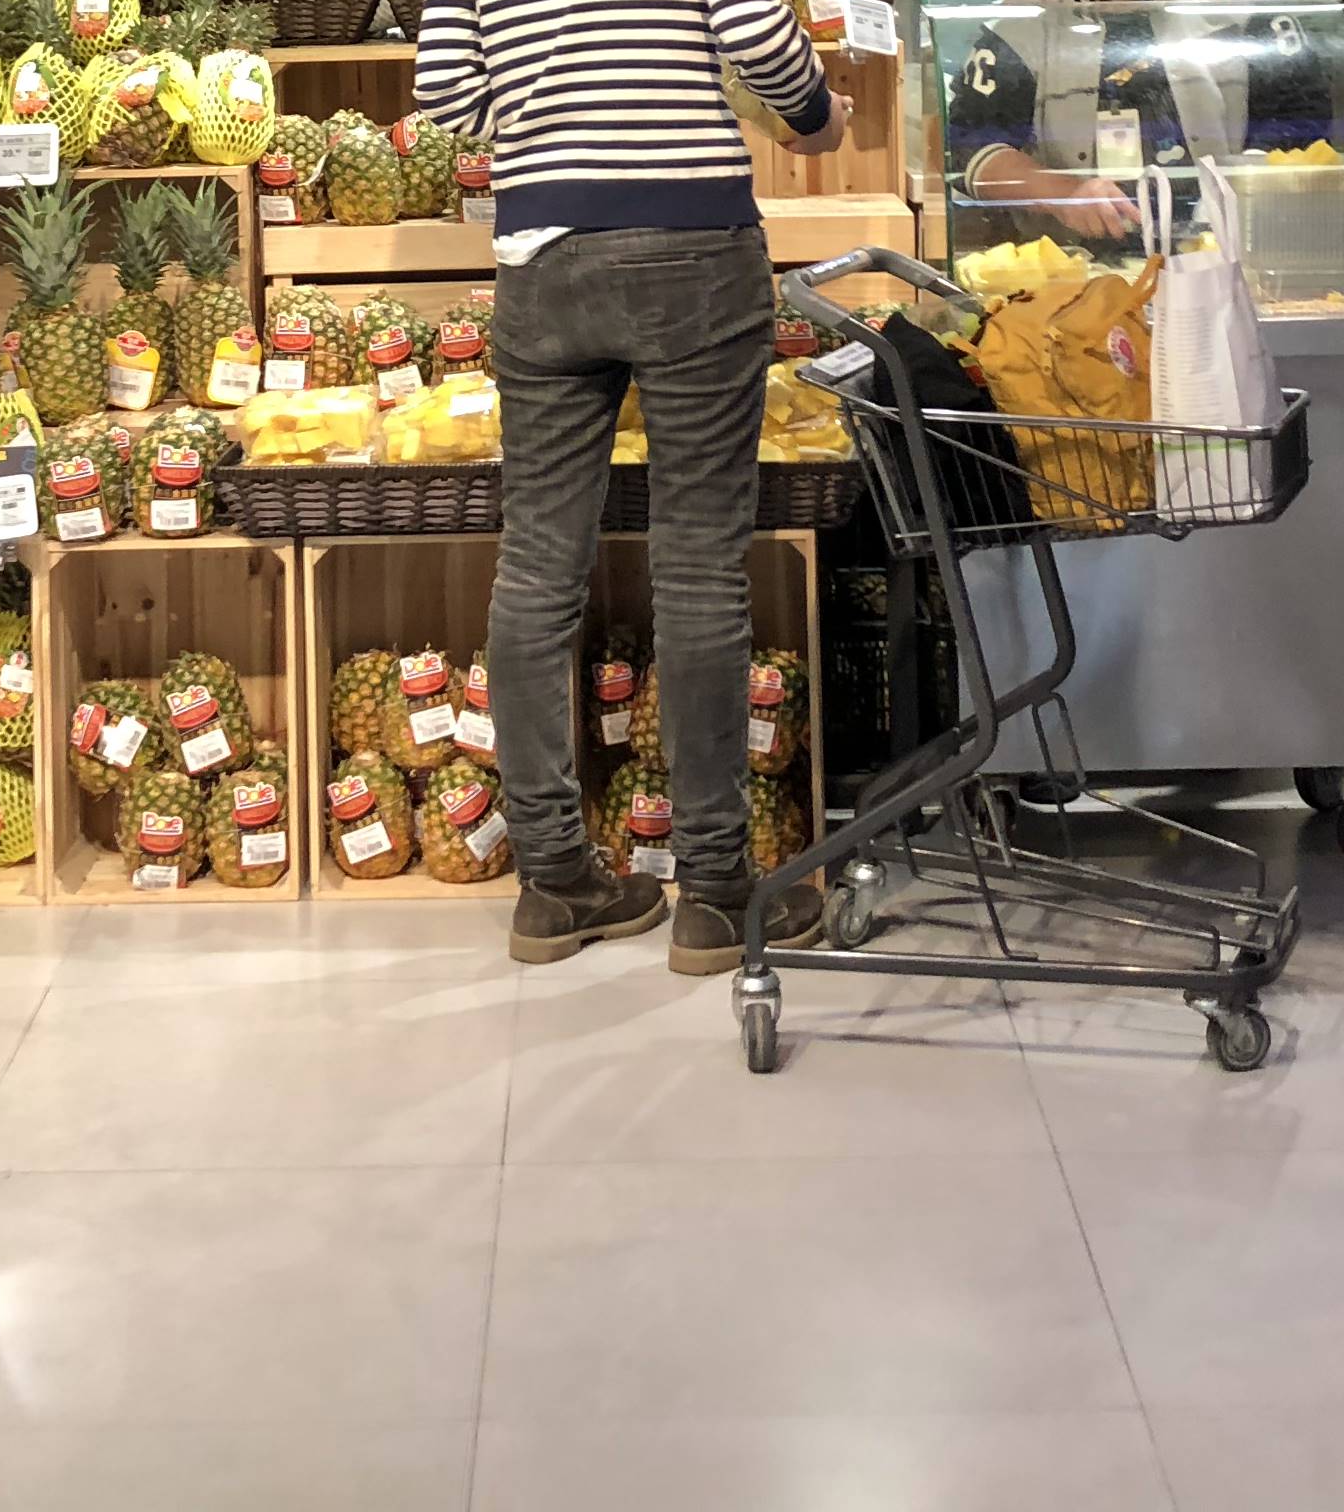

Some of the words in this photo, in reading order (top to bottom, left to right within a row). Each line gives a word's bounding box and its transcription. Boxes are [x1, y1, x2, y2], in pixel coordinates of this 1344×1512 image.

[262, 147, 289, 166] Dole
[460, 152, 492, 167] Dole
[278, 314, 307, 329] Dole
[443, 322, 476, 338] Dole
[779, 321, 810, 334] Dole
[161, 446, 197, 462] Dole
[52, 456, 90, 475] Dole
[404, 653, 439, 672] Dole
[170, 686, 205, 708] Dole
[238, 785, 273, 804] Dole
[334, 778, 361, 797] Dole
[442, 784, 478, 807] Dole
[635, 796, 670, 811] Dole
[145, 815, 181, 829] Dole
